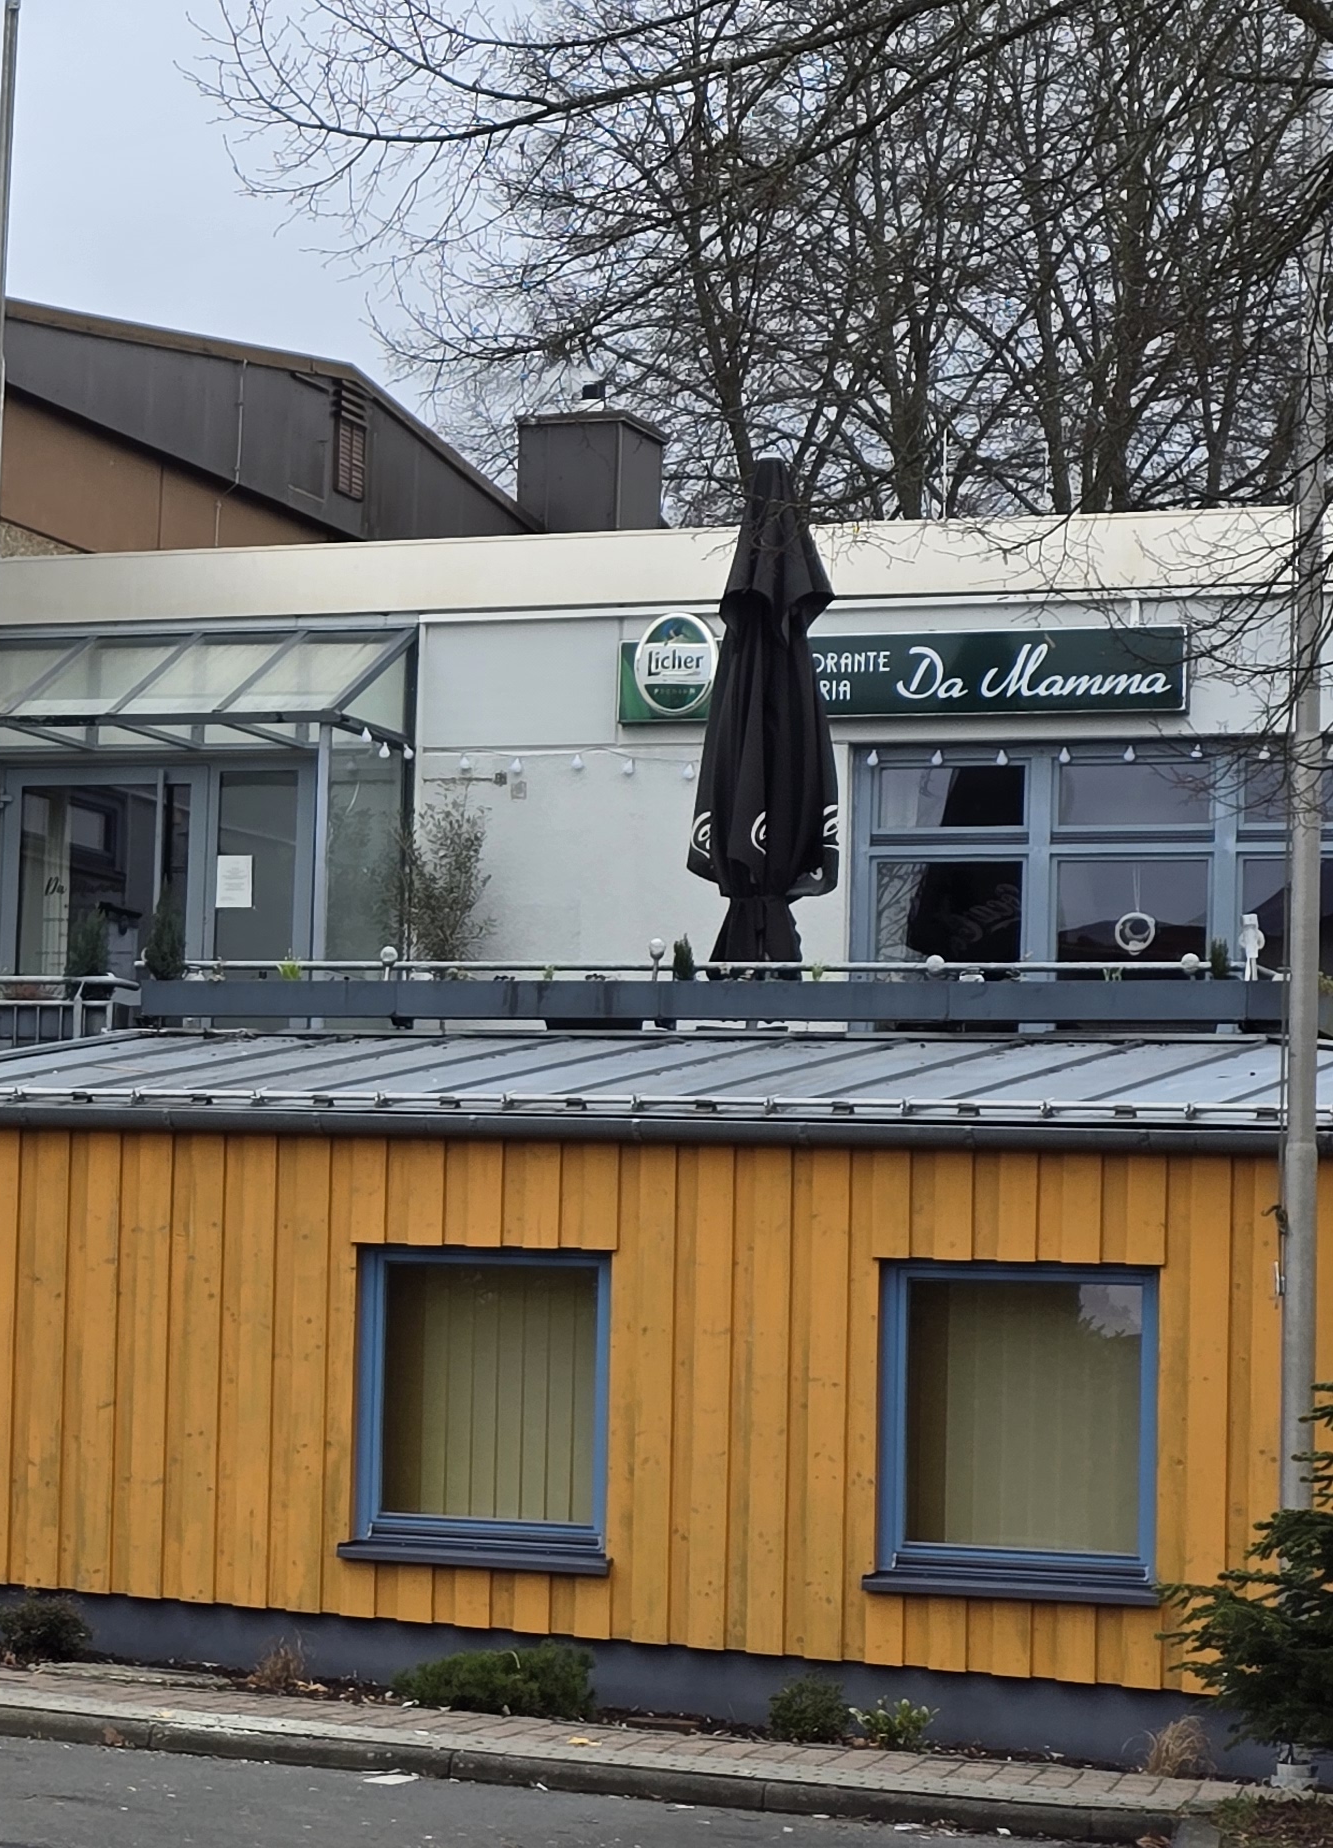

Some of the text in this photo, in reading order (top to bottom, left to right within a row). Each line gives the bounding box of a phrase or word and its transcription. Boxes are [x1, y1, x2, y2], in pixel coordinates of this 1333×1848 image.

[647, 648, 704, 677] Licher
[896, 643, 1172, 699] Da Mamma
